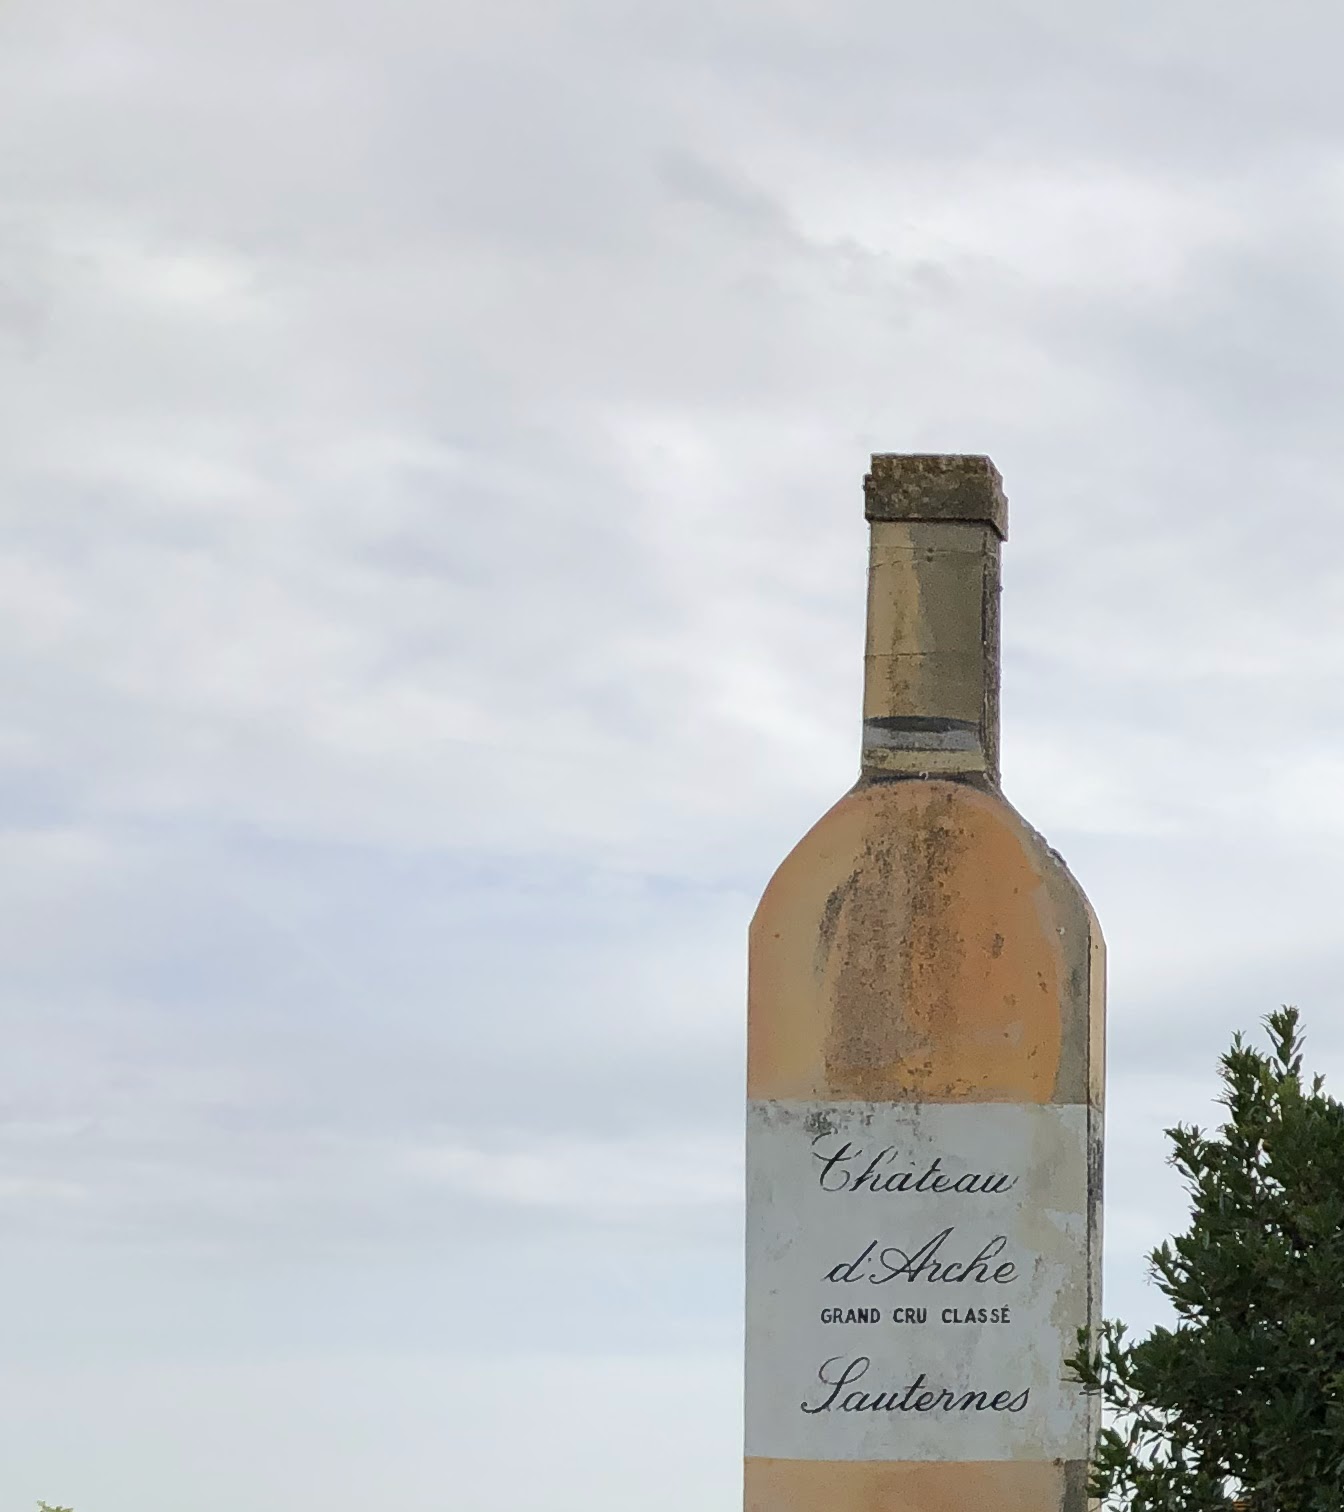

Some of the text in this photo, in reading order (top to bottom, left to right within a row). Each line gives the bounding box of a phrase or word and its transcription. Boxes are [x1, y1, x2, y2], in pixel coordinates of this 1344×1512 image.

[823, 1226, 1020, 1285] d'Arche
[820, 1307, 881, 1325] GRAND
[892, 1307, 928, 1325] CRU
[800, 1356, 1031, 1415] Sauternes
